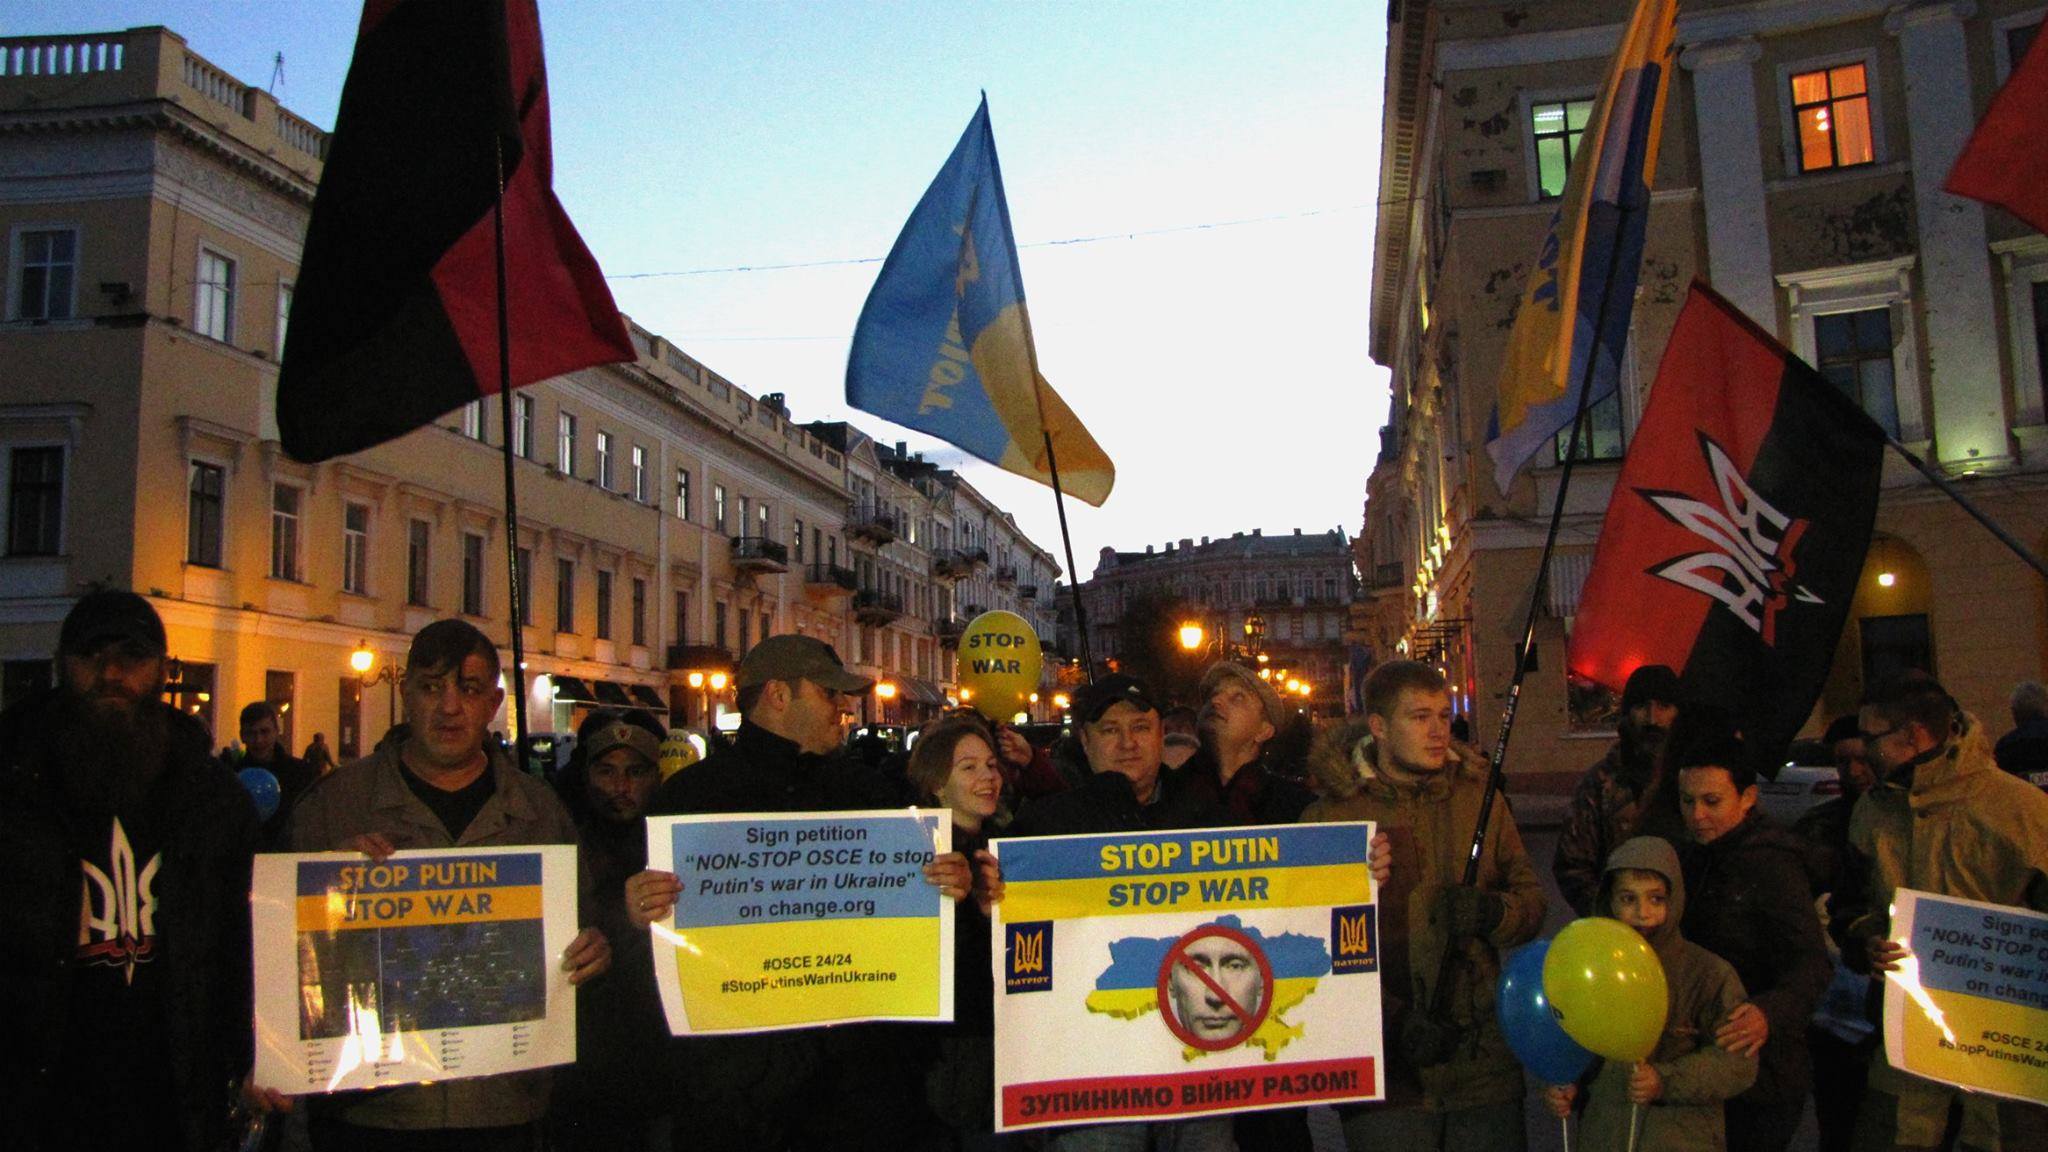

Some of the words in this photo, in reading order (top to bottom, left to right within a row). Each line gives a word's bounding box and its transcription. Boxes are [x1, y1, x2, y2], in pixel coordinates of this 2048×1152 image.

[969, 632, 1026, 648] STOP
[972, 658, 1021, 674] WAR
[746, 827, 790, 847] Sign
[796, 825, 868, 846] petition
[806, 849, 863, 867] OSCE
[869, 850, 887, 865] to
[893, 849, 935, 867] stop
[1100, 842, 1182, 872] STOP
[1190, 836, 1280, 866] PUTIN
[340, 864, 409, 890] STOP
[419, 861, 498, 886] PUTIN
[699, 877, 765, 896] Putin's
[771, 877, 806, 892] war
[810, 874, 828, 890] in
[1108, 881, 1190, 908] STOP
[1200, 876, 1270, 903] WAR
[344, 896, 414, 922] STOP
[425, 892, 493, 917] WAR
[739, 903, 762, 918] on
[769, 899, 876, 918] change.org
[1982, 915, 2023, 935] Sign
[763, 955, 813, 971] #OSCE
[816, 953, 853, 968] 24/24
[1932, 948, 1994, 972] Putin's
[2000, 963, 2034, 979] war
[1966, 979, 1990, 993] on
[1982, 1030, 2033, 1049] #OSCE
[1020, 1086, 1175, 1118] ЗУПИНИМО
[1182, 1076, 1255, 1107] ВІЙНУ
[1262, 1068, 1359, 1099] РАЗОМ!
